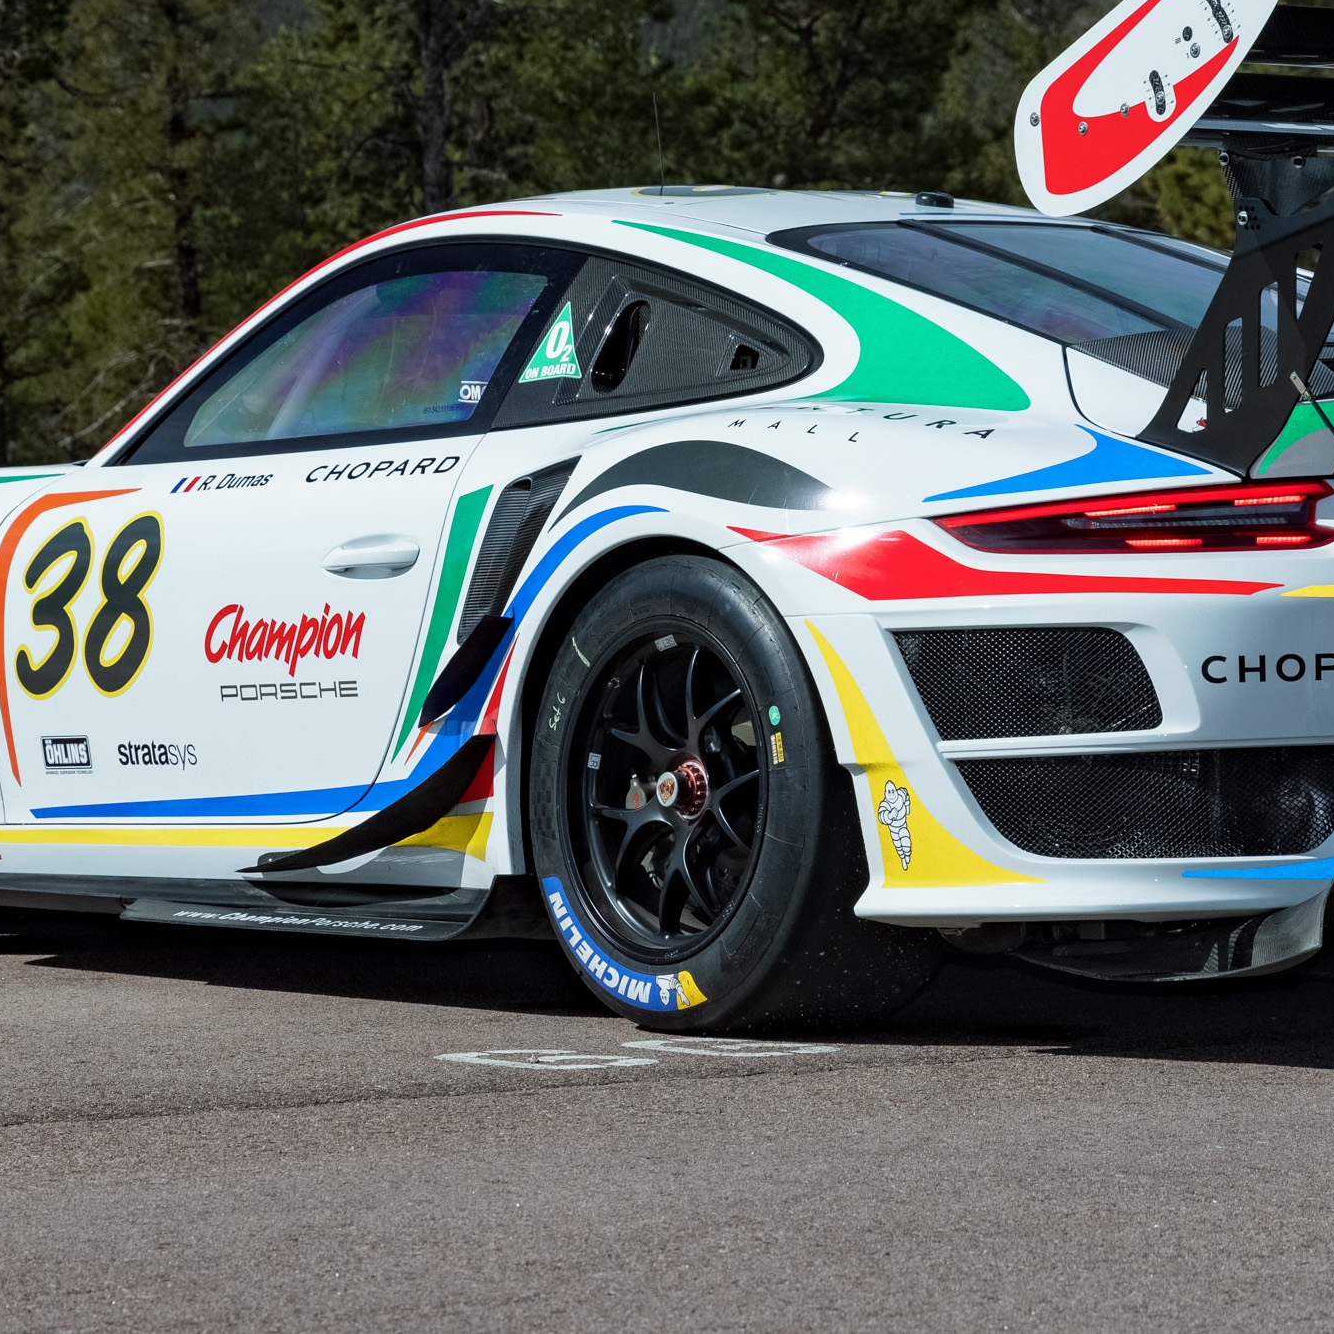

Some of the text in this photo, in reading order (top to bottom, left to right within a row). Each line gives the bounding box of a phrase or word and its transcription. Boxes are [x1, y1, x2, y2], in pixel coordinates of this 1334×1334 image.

[525, 363, 576, 379] ON BOARD
[727, 418, 859, 443] MALL
[305, 455, 461, 483] CHOPARD
[197, 473, 274, 492] R. Dumas
[14, 510, 165, 701] 38
[204, 602, 366, 678] Champion
[220, 680, 358, 702] PORSCHE
[44, 739, 88, 764] ÖHLINS
[117, 739, 198, 771] stratasys
[172, 910, 424, 932] www.ChampionPorsche.com
[548, 891, 652, 1004] MICHELIN
